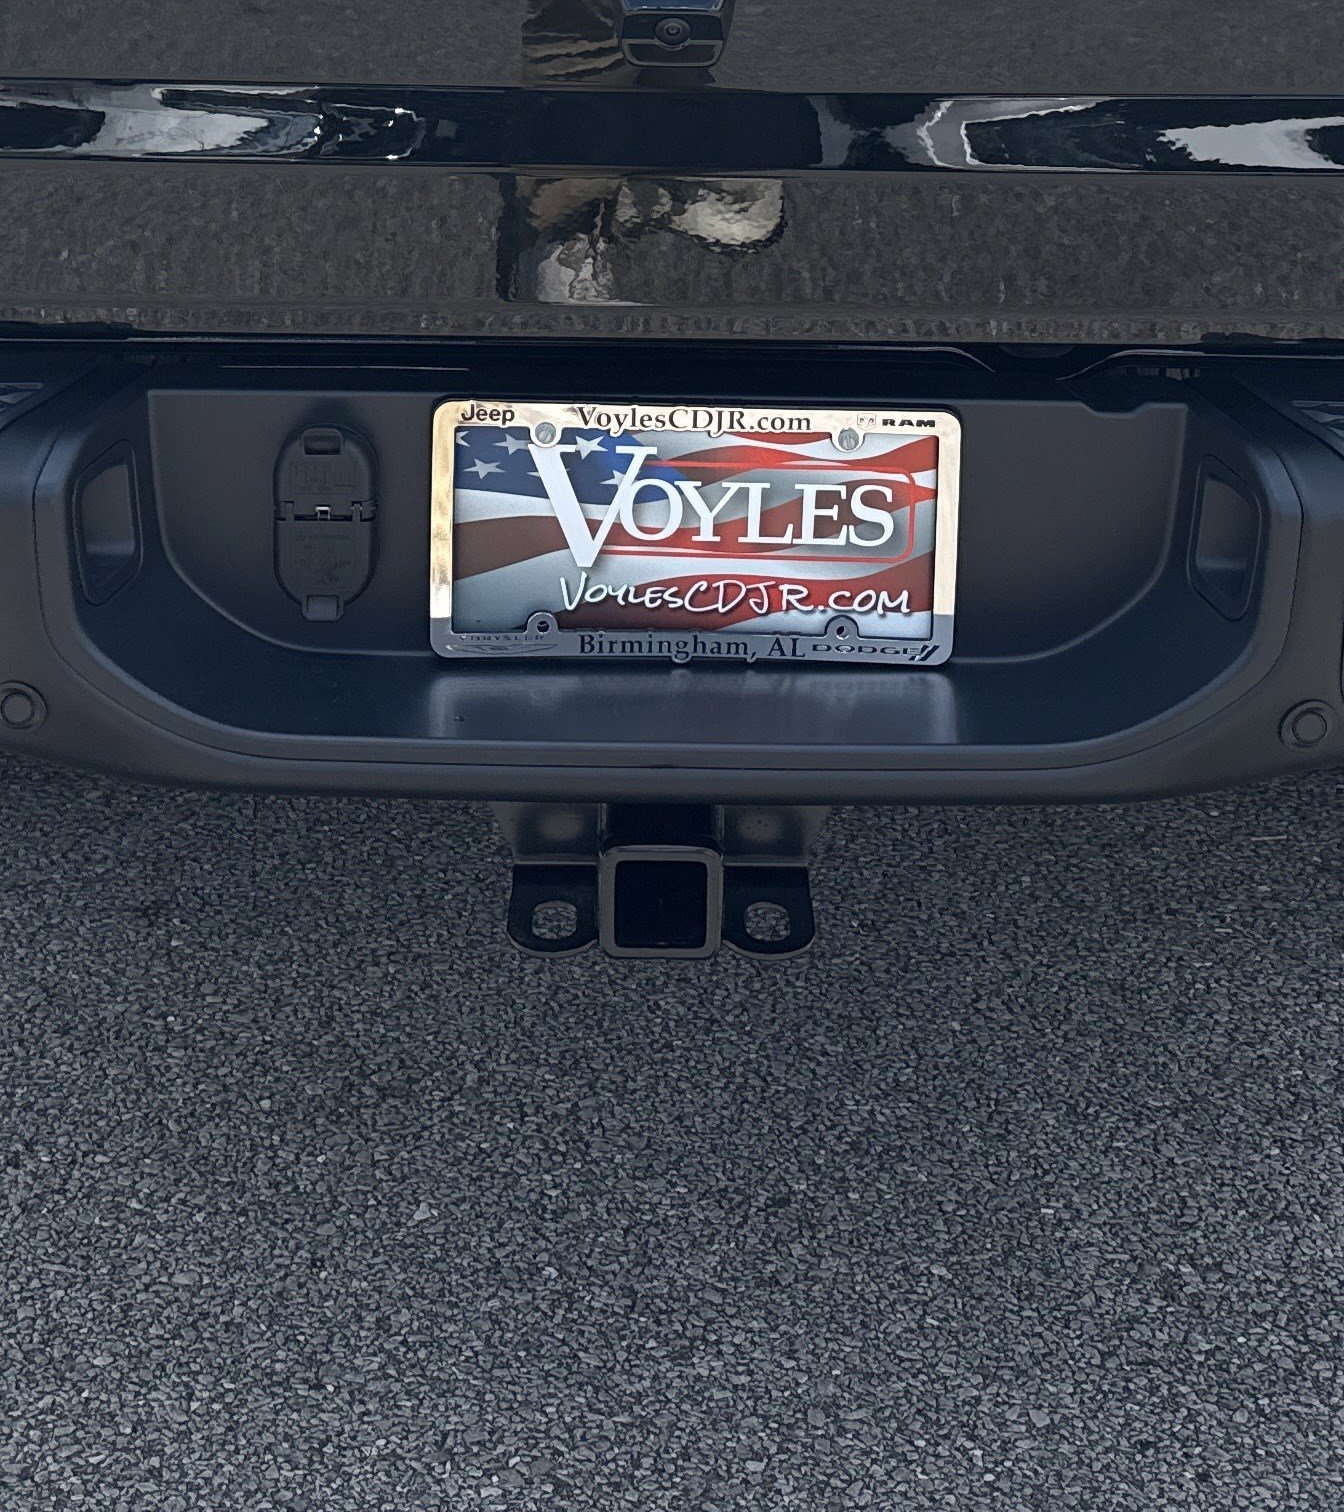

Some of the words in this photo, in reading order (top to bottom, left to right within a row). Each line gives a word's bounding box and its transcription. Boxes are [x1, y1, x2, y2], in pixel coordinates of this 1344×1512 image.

[461, 403, 515, 426] Jeep
[577, 406, 812, 436] VoylesCDJR.com
[881, 418, 936, 428] RAM
[529, 444, 895, 569] VOYLES
[578, 633, 756, 661] Birmingham,
[768, 637, 806, 658] AL
[812, 644, 921, 656] DODGE
